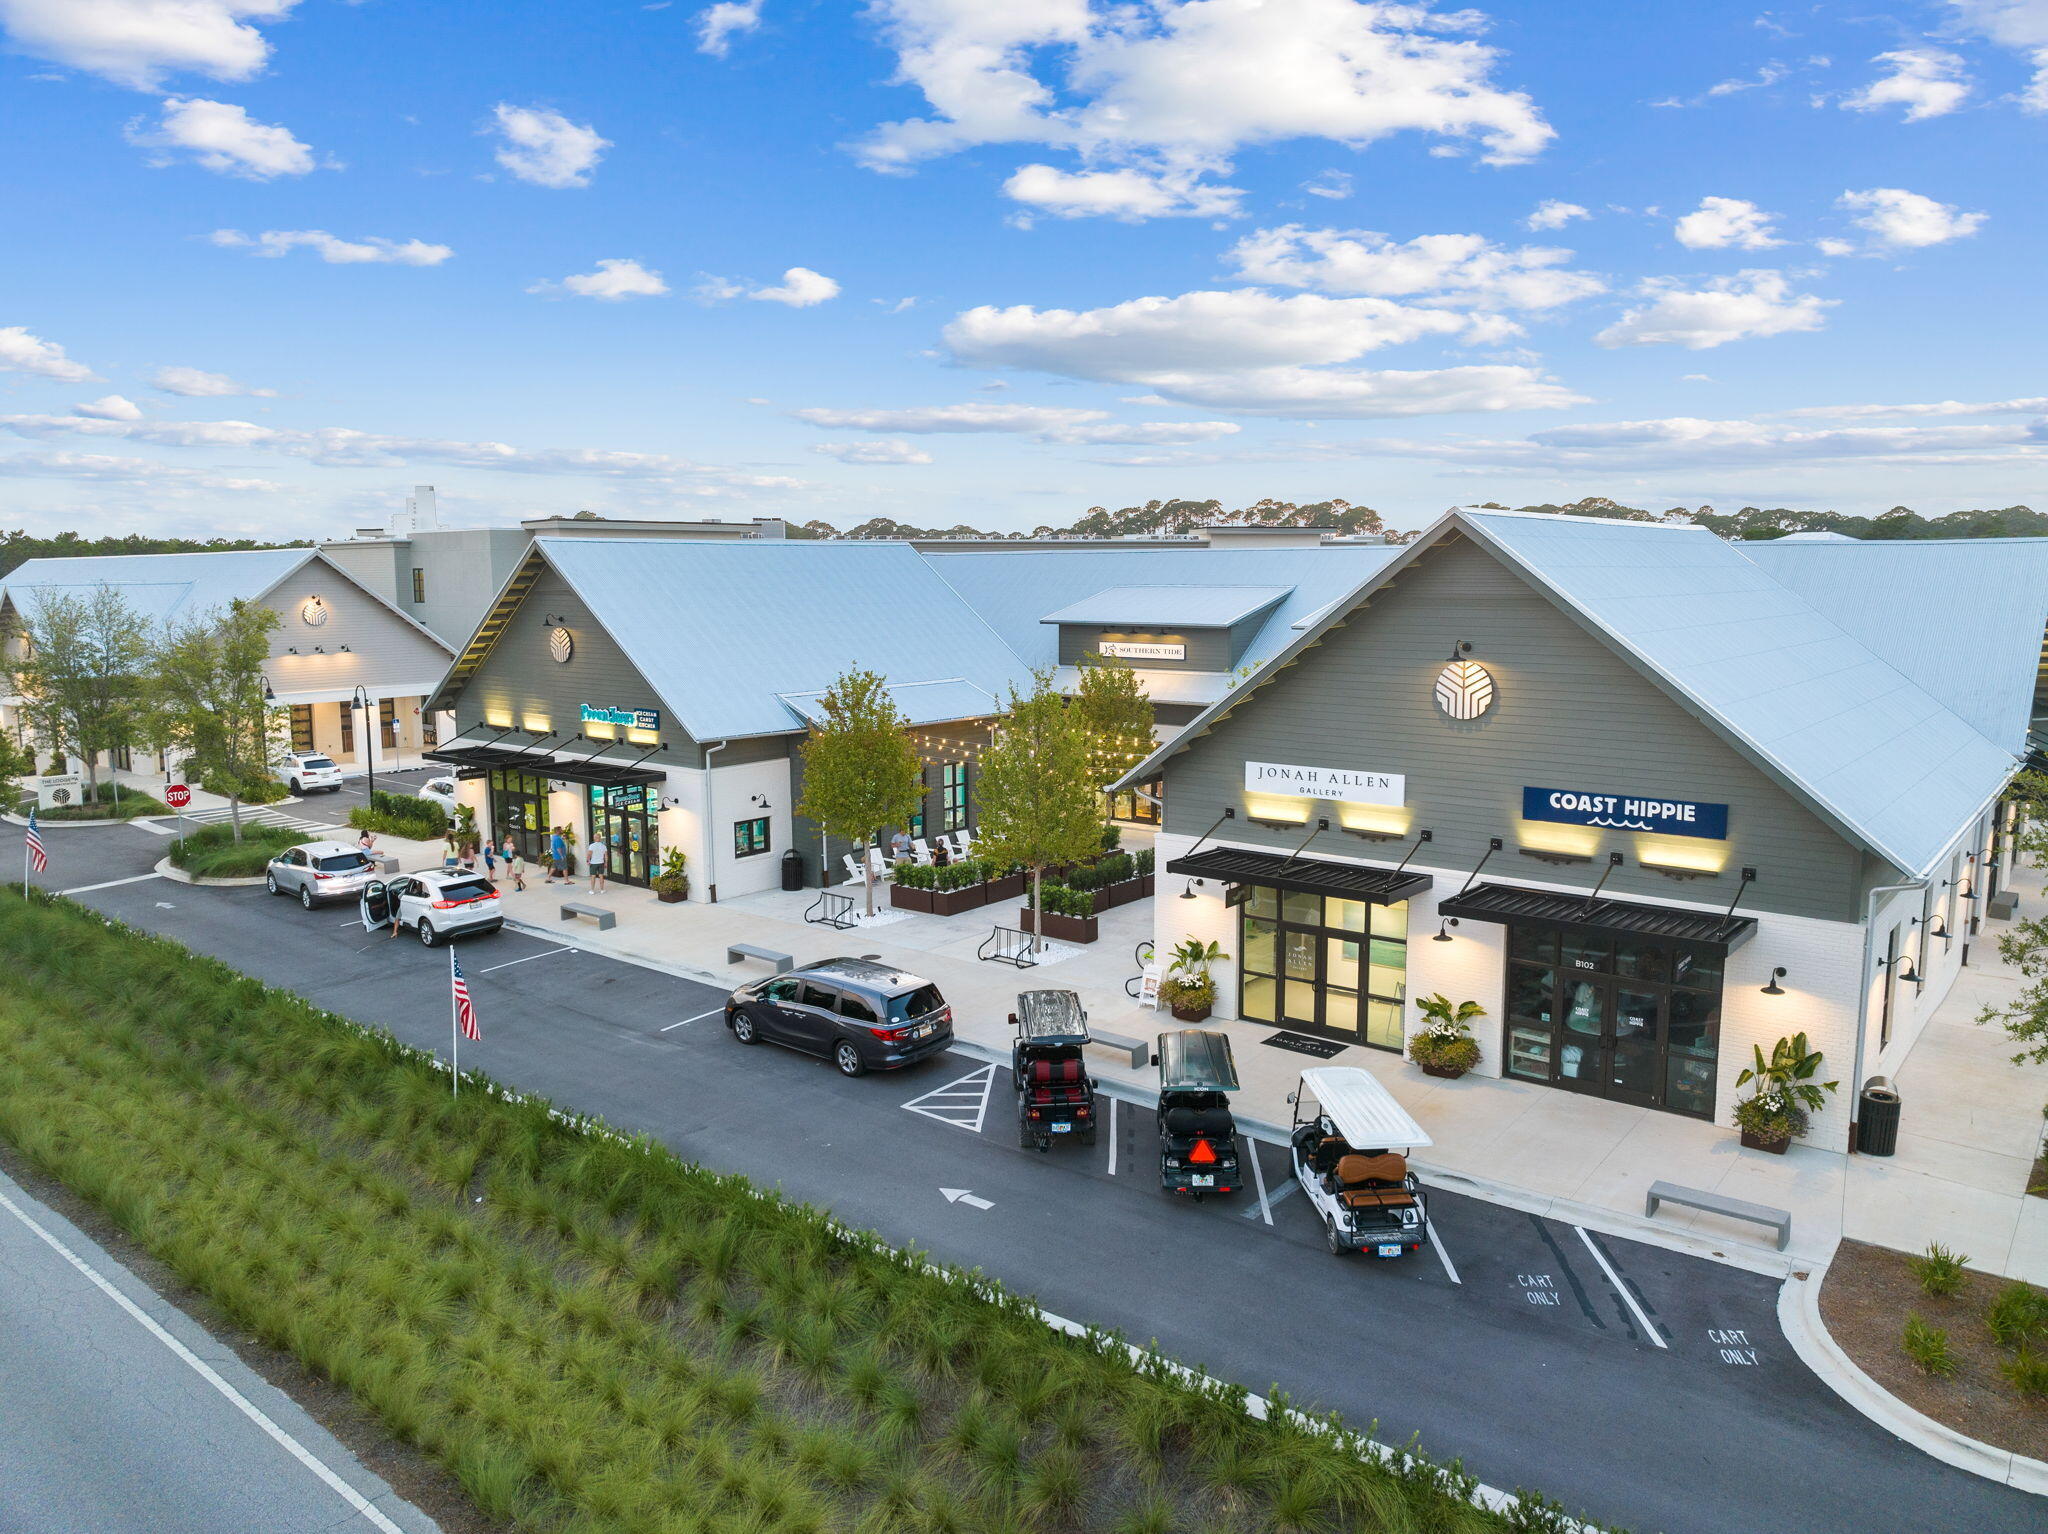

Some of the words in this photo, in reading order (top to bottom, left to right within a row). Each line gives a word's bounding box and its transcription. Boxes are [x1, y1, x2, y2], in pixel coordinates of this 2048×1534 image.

[1258, 767, 1318, 782] JONAH
[1329, 774, 1390, 788] ALLEN
[167, 790, 190, 802] STOP
[1299, 787, 1344, 797] GALLERY
[1549, 792, 1617, 814] COAST
[1624, 800, 1696, 822] HIPPIE
[1575, 960, 1594, 970] B102
[1517, 1274, 1554, 1288] CART
[1526, 1291, 1561, 1306] ONLY
[1708, 1329, 1751, 1345] CART
[1720, 1349, 1759, 1366] ONLY
